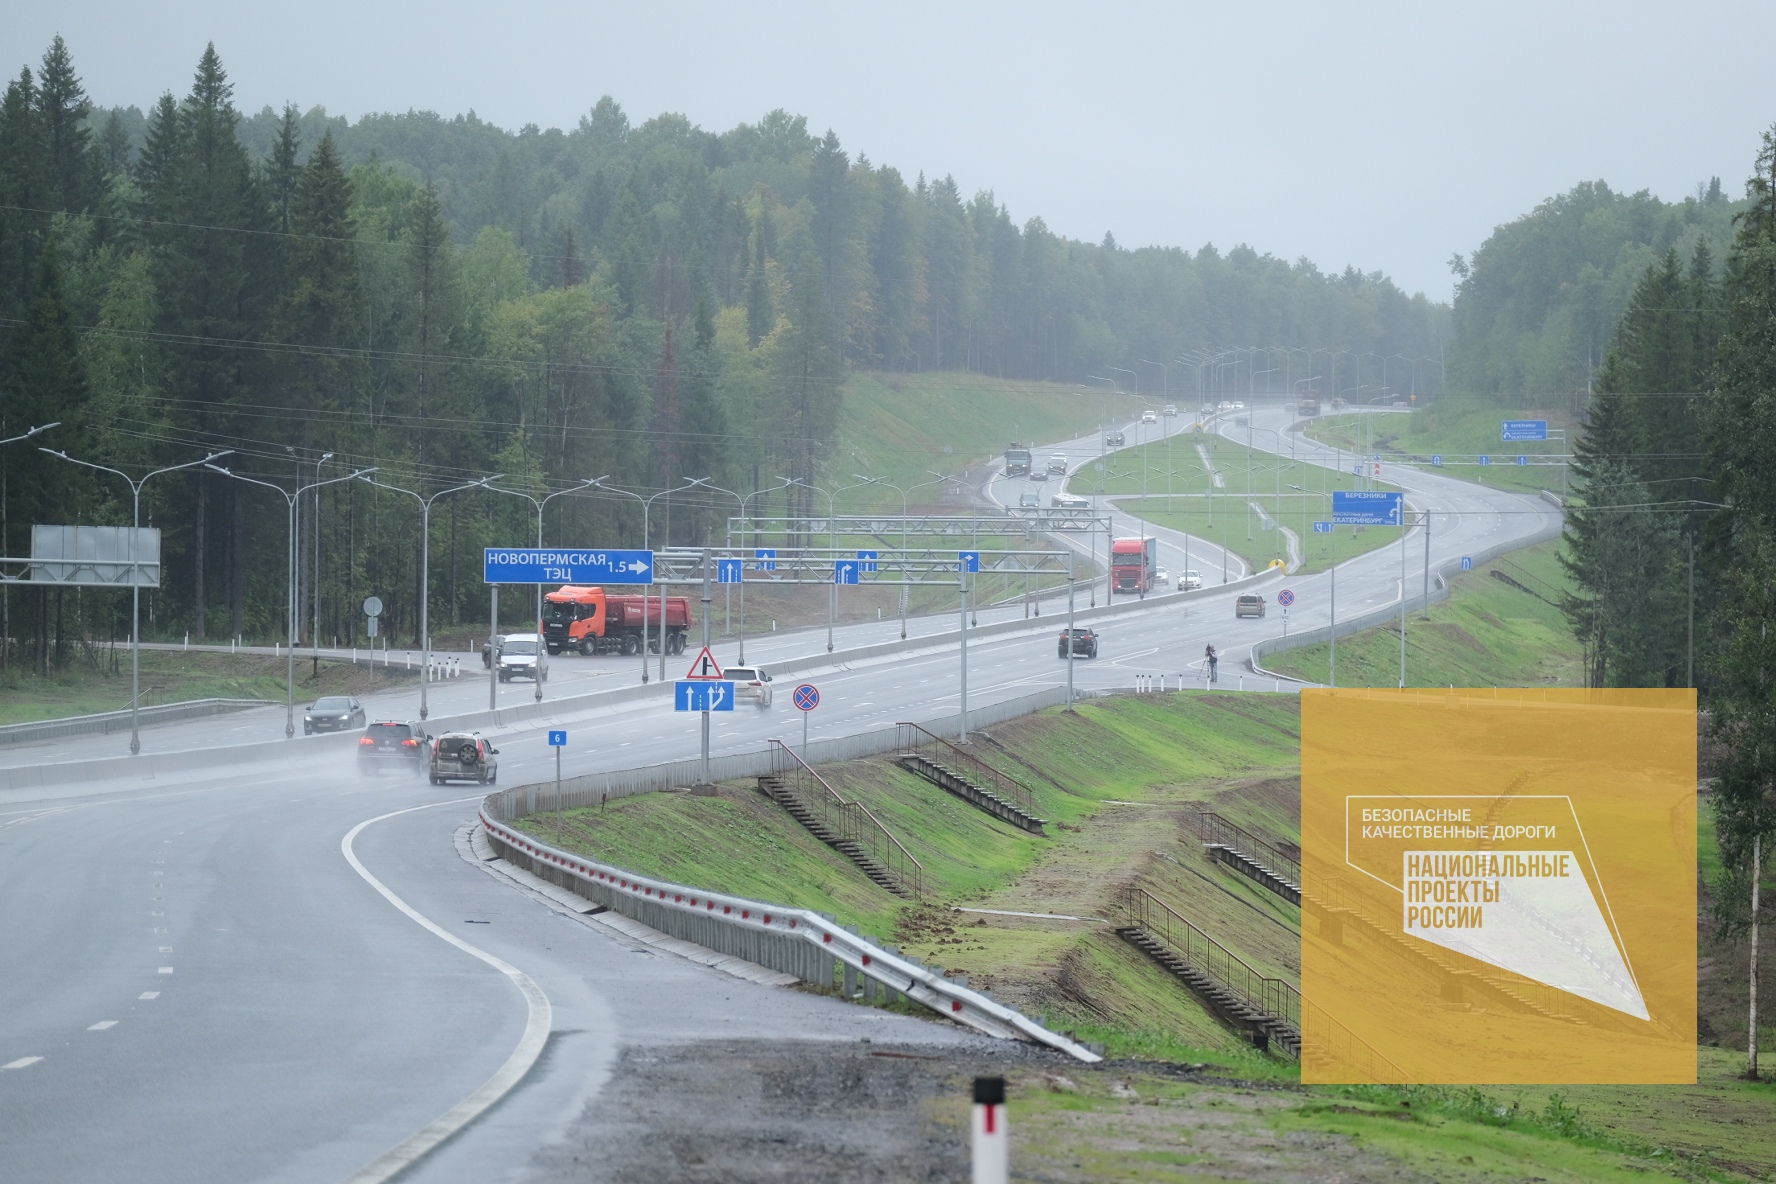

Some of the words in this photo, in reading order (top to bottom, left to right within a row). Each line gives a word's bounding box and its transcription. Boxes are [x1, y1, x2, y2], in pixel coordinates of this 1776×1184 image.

[488, 553, 606, 566] НОВОПЕРМСКАЯ
[607, 561, 627, 573] 1.5
[543, 567, 572, 582] ТЭЦ
[554, 733, 561, 743] 6
